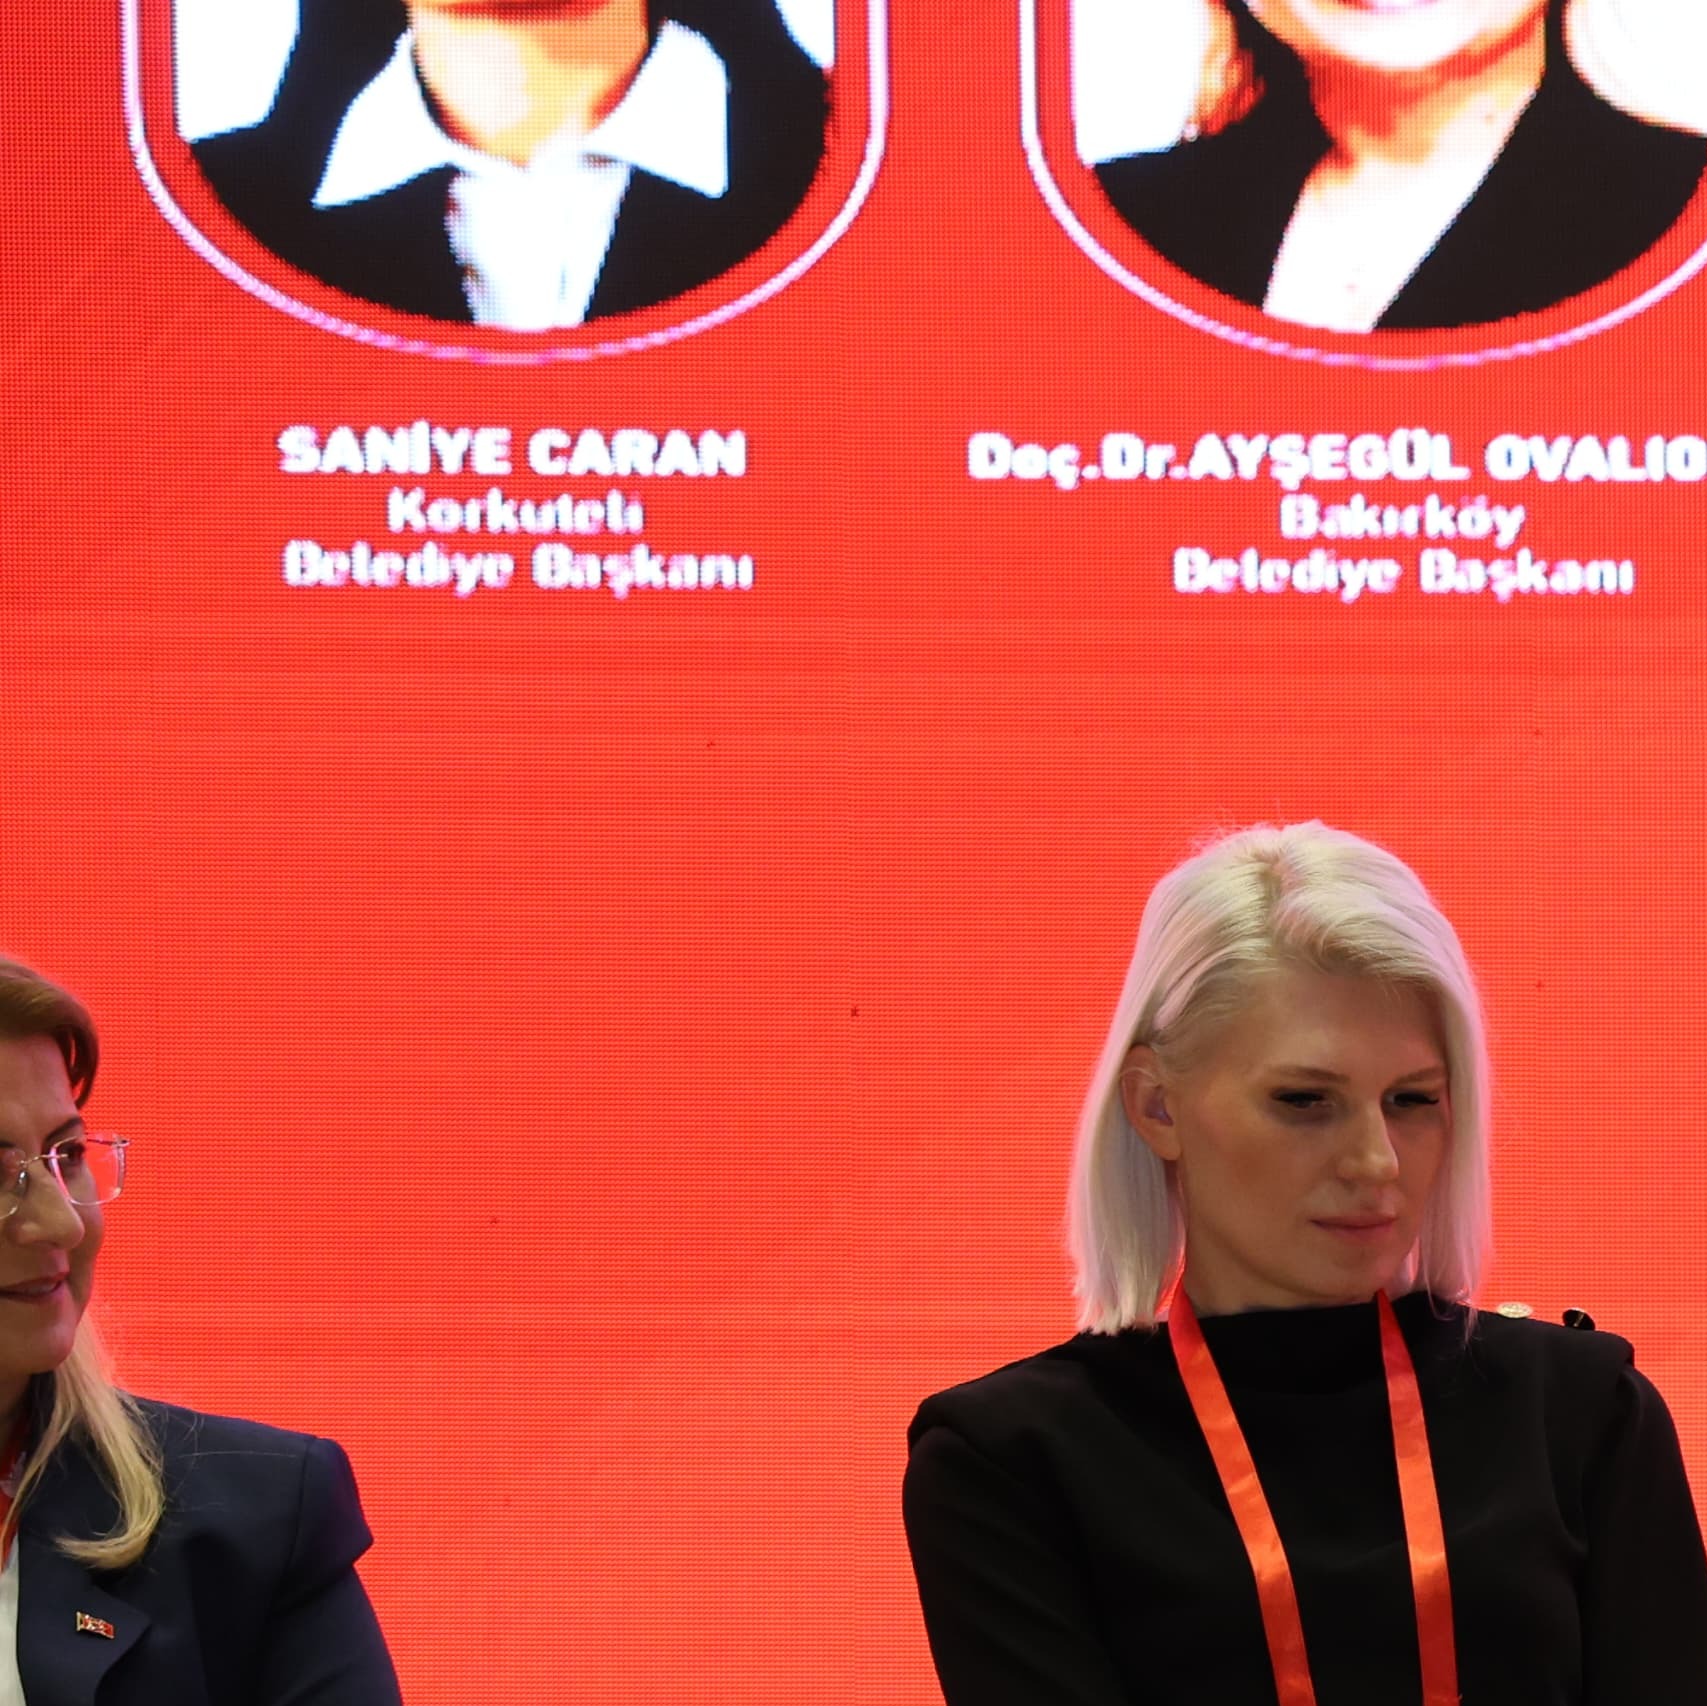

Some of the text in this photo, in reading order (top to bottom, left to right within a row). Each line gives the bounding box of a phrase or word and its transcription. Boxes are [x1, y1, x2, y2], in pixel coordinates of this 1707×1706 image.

[277, 418, 747, 478] SANİYE CARAN
[967, 427, 1472, 493] Doç.Dr.AYŞEGÜL
[1279, 492, 1527, 548] Bakırköy
[282, 539, 754, 600] Belediye Başkanı
[1172, 544, 1636, 605] Belediye Başkanı
